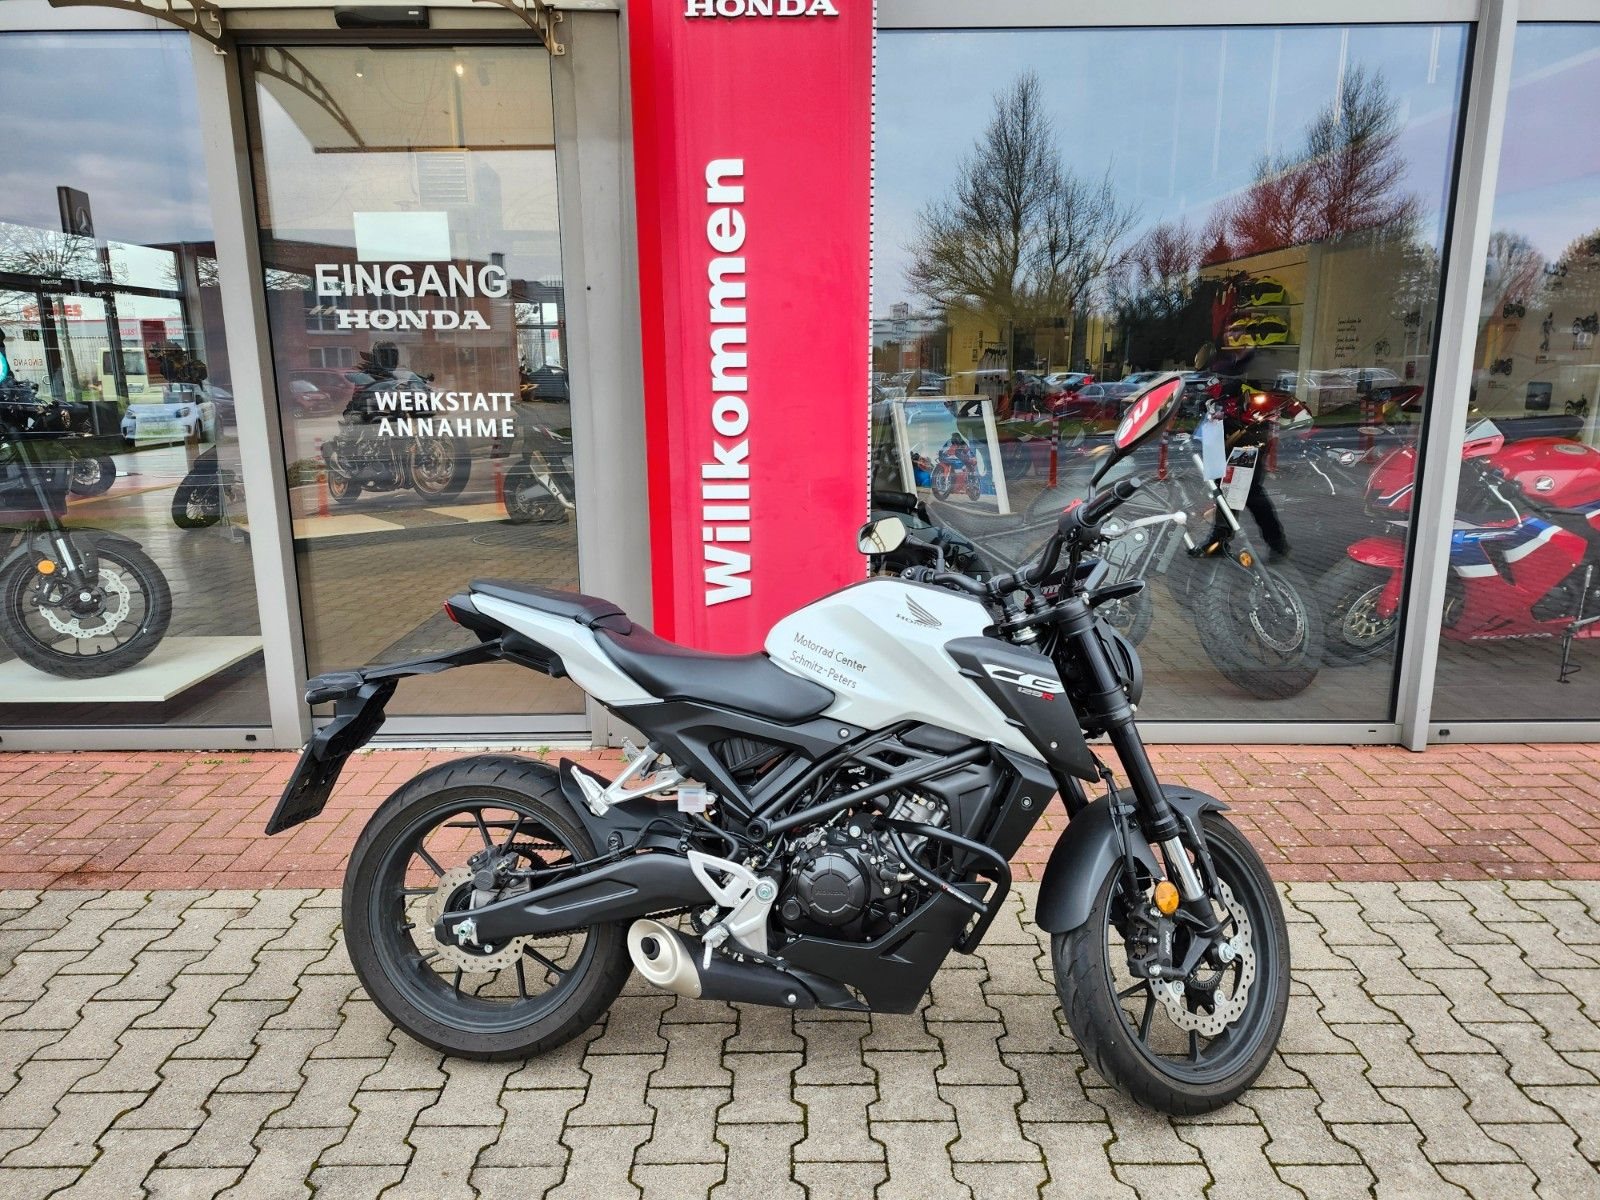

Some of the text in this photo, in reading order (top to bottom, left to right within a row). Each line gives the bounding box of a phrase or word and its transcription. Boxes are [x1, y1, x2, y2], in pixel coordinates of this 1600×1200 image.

[685, 0, 839, 17] HONDA
[315, 263, 509, 298] EINGANG
[336, 309, 491, 330] HONDA
[702, 158, 752, 606] Willkommen
[375, 391, 514, 411] WERKSTATT
[378, 418, 515, 438] ANNAHME
[793, 632, 867, 673] Motorrad Center
[790, 650, 857, 689] Schmitz-Peters
[982, 663, 1065, 694] CB
[1017, 686, 1055, 701] 125R
